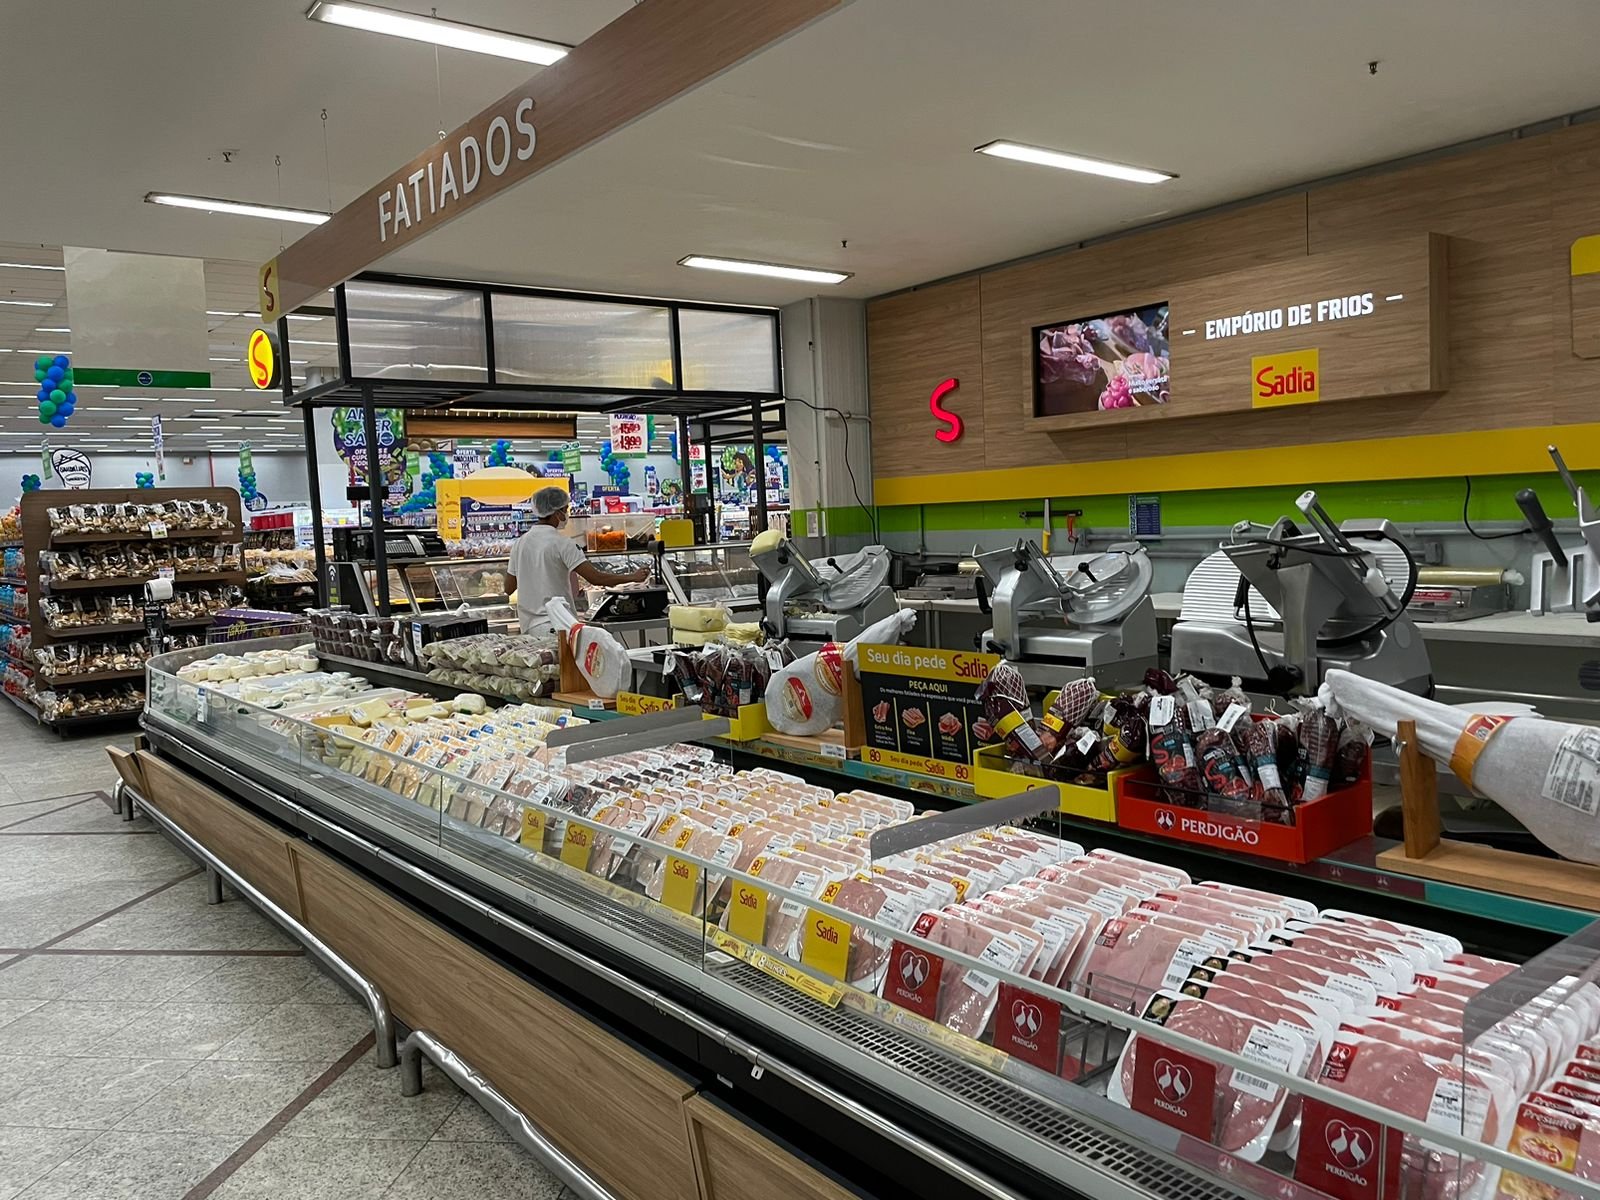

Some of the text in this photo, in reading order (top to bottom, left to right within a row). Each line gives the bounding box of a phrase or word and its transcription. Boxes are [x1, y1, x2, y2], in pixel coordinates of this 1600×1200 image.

[377, 97, 537, 242] FATIADOS
[1205, 292, 1374, 340] EMPÓRIO DE FRIOS
[1256, 366, 1316, 398] Sadia
[867, 650, 989, 679] Seu dia pede Sadia
[909, 680, 948, 693] PEÇA AQUI
[869, 748, 882, 763] 80
[924, 759, 945, 775] Sadia
[955, 764, 969, 780] 80
[567, 824, 588, 847] Sadia
[1181, 817, 1260, 846] PERDIGÃO
[672, 859, 690, 880] Sadia
[739, 888, 758, 910] Sadia
[824, 884, 838, 898] 80
[815, 919, 839, 945] Sadia
[896, 987, 923, 1004] PERDIGÃO
[1011, 1035, 1038, 1051] PERDIGÃO
[1153, 1097, 1188, 1118] PERDIGÃO
[1523, 1108, 1577, 1131] Presunto
[1325, 1162, 1368, 1187] PERDIGÃO
